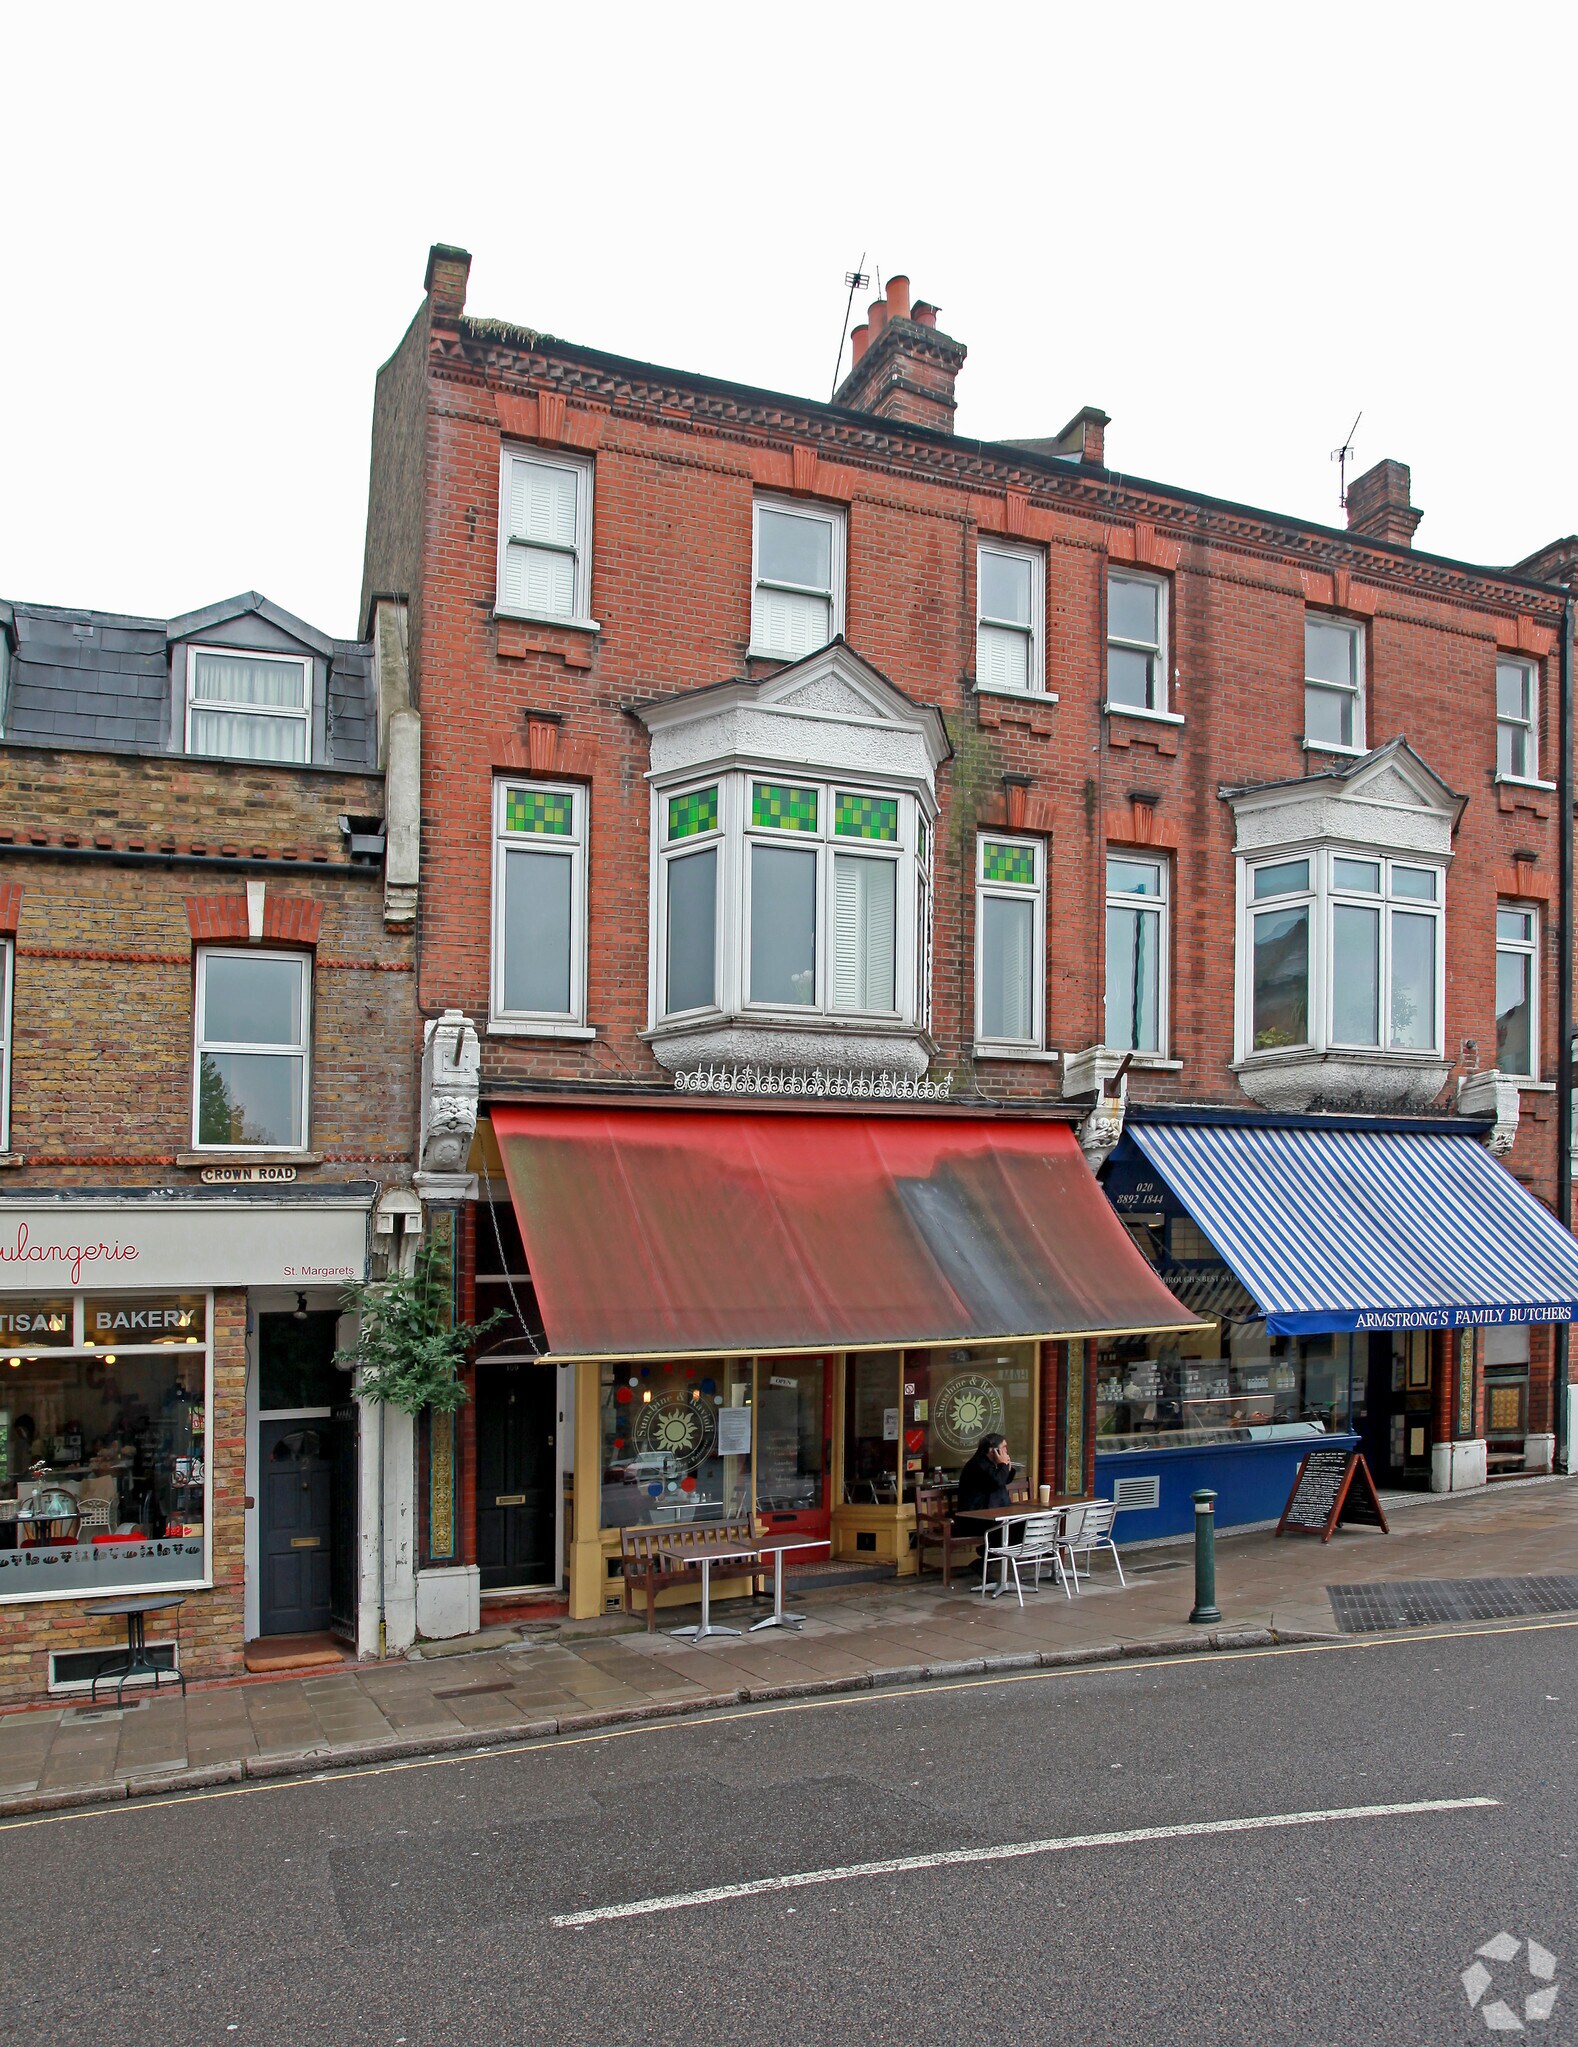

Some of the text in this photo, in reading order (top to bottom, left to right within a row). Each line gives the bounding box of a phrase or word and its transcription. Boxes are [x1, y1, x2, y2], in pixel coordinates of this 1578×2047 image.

[205, 1168, 293, 1181] CROWN ROAD
[1136, 1182, 1153, 1192] 020
[1117, 1194, 1164, 1204] 8892 1844
[0, 1222, 139, 1285] ulangerie
[283, 1266, 355, 1277] St. Margarets
[1202, 1275, 1219, 1283] BEST
[96, 1309, 195, 1329] BAKERY
[1355, 1306, 1572, 1328] ARMSTRONG'S FAMILY BUTCHERS
[936, 1379, 966, 1418] Sunshine
[969, 1376, 978, 1386] &
[981, 1380, 1001, 1414] Ravioli
[637, 1395, 672, 1437] Sunshine
